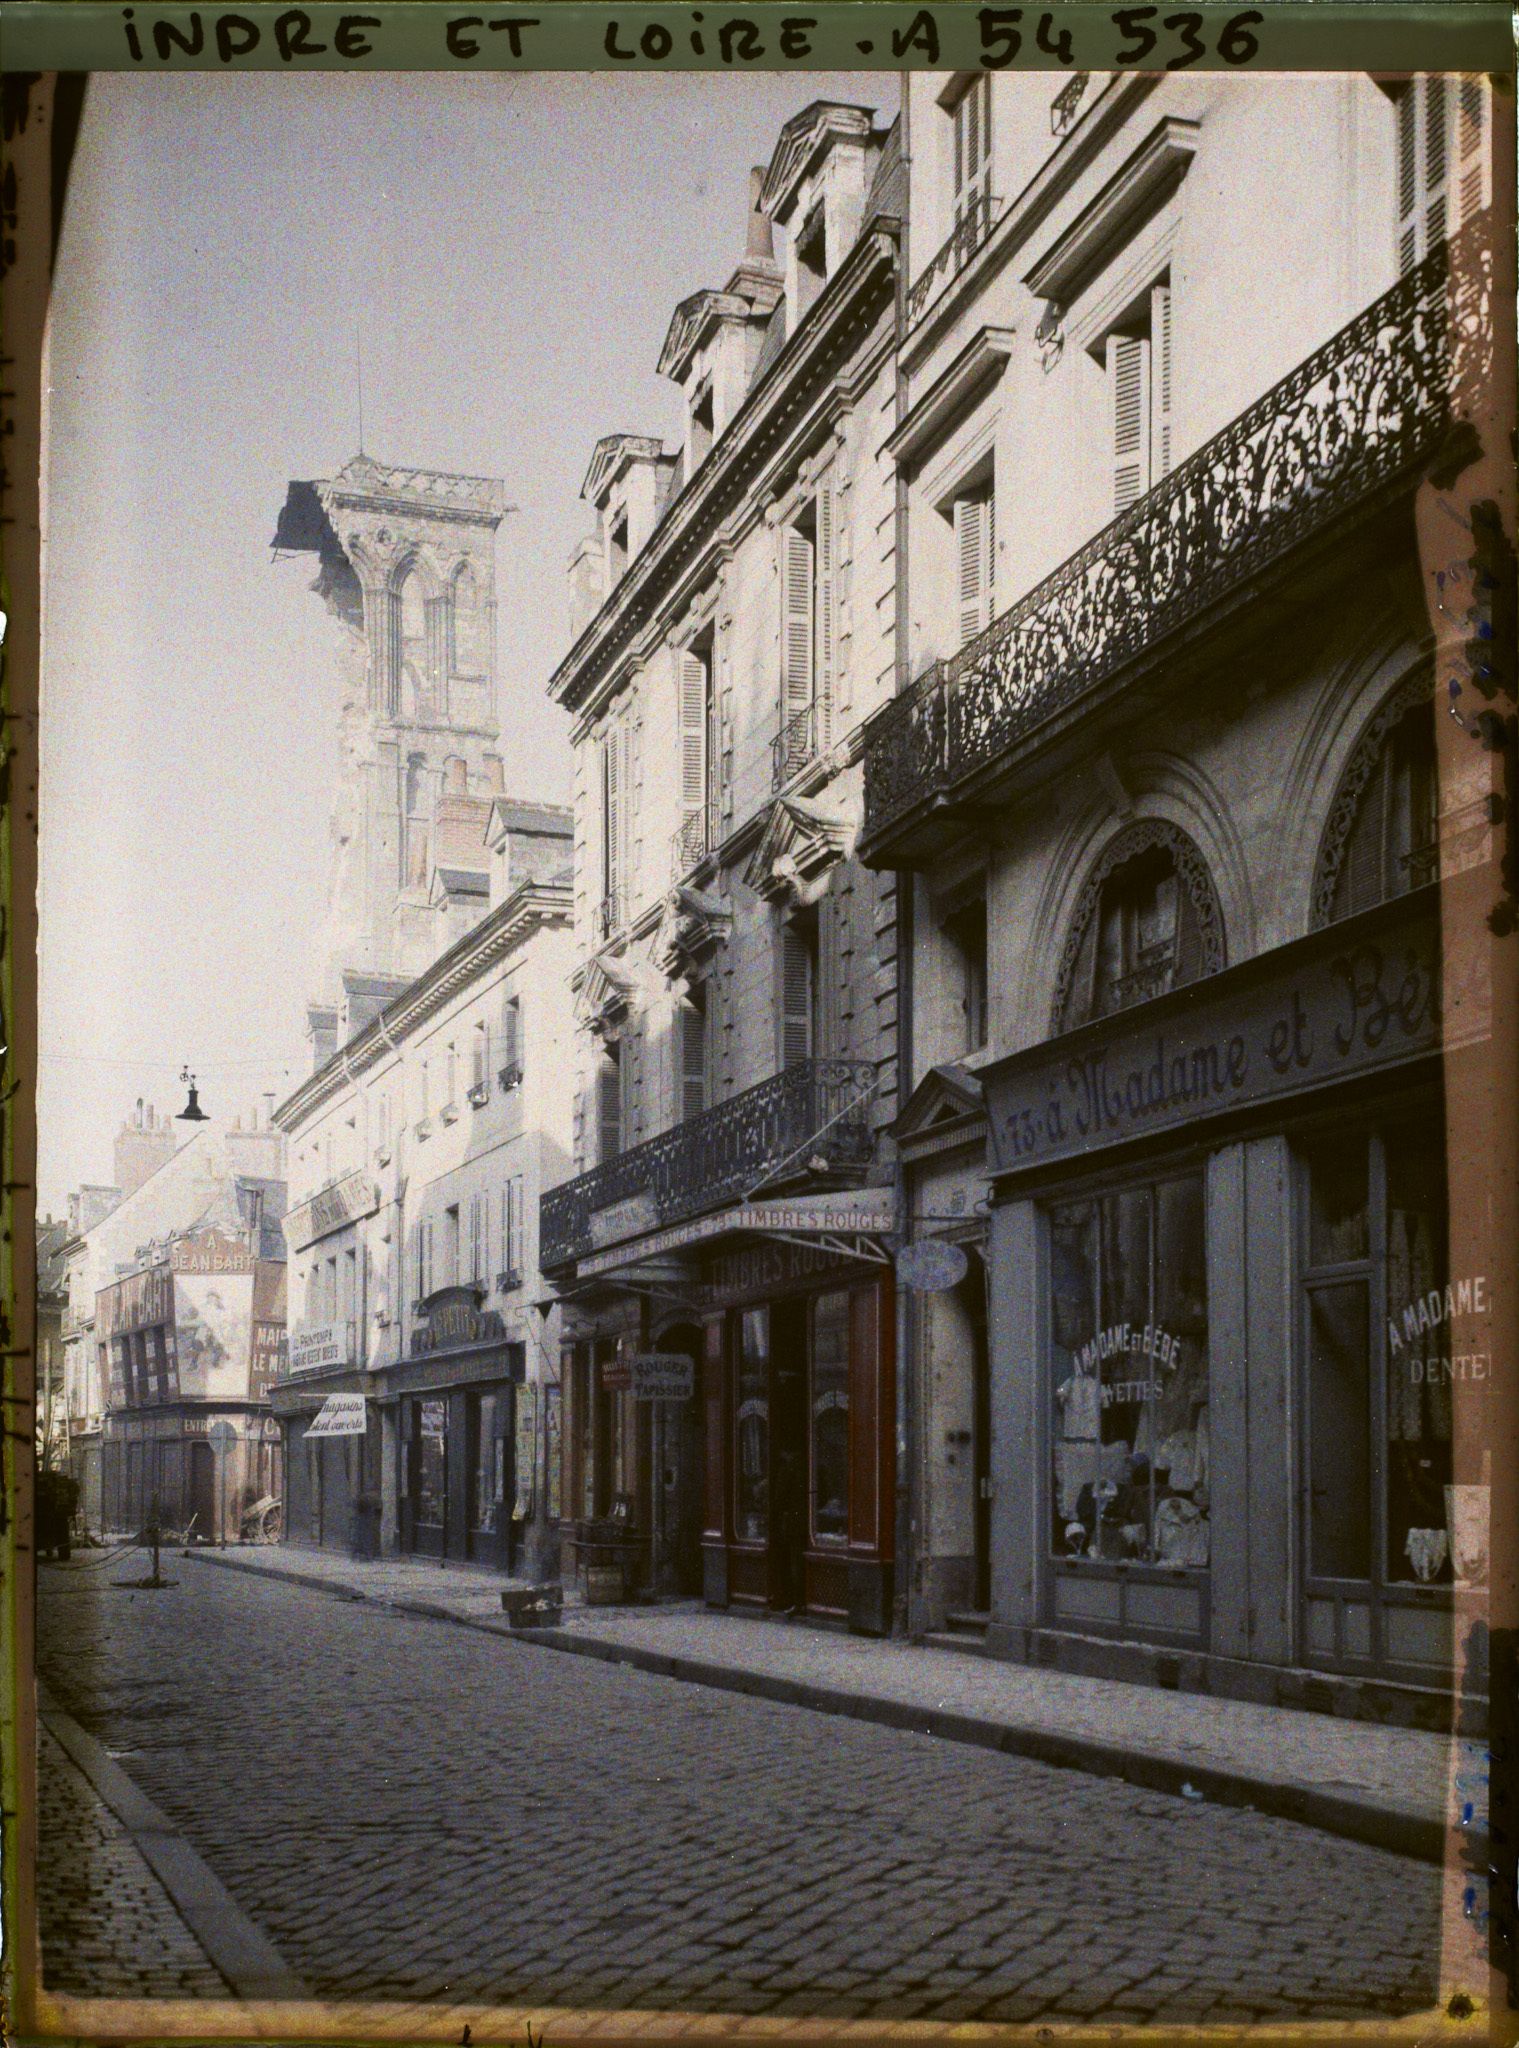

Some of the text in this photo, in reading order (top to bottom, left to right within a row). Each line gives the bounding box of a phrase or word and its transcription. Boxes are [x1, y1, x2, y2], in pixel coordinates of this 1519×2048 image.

[1069, 1035, 1247, 1136] Madame
[1267, 990, 1313, 1074] et
[738, 1209, 892, 1230] TIMBRES ROUGES
[172, 1254, 254, 1271] JEAN BART
[711, 1242, 783, 1296] TIMBRES
[1403, 1276, 1486, 1341] MADAME
[1081, 1323, 1130, 1372] MADAME
